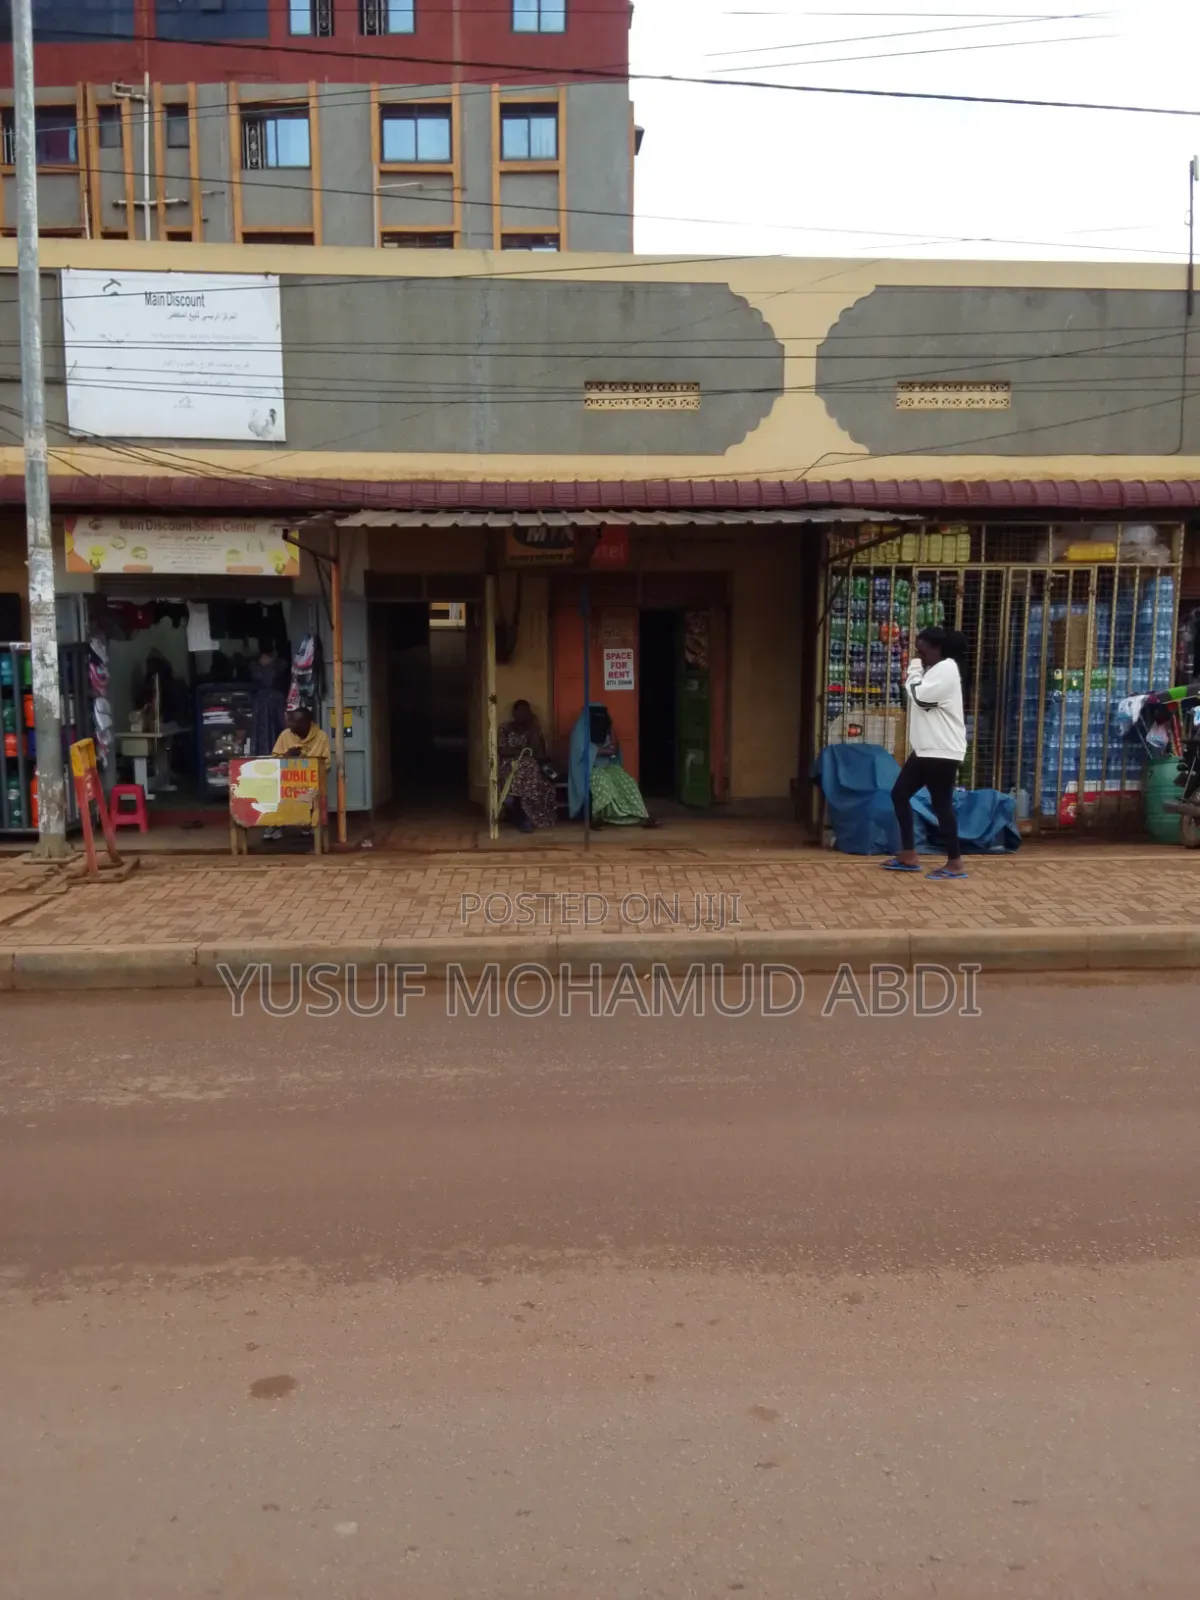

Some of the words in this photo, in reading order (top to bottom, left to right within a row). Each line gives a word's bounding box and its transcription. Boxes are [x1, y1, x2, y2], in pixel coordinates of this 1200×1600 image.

[144, 291, 165, 306] Main
[166, 292, 206, 308] Discount
[119, 518, 144, 531] Main
[145, 518, 192, 531] Discount
[223, 520, 258, 532] Center
[605, 651, 632, 661] SPACE
[610, 661, 628, 669] FOR
[608, 670, 631, 679] RENT
